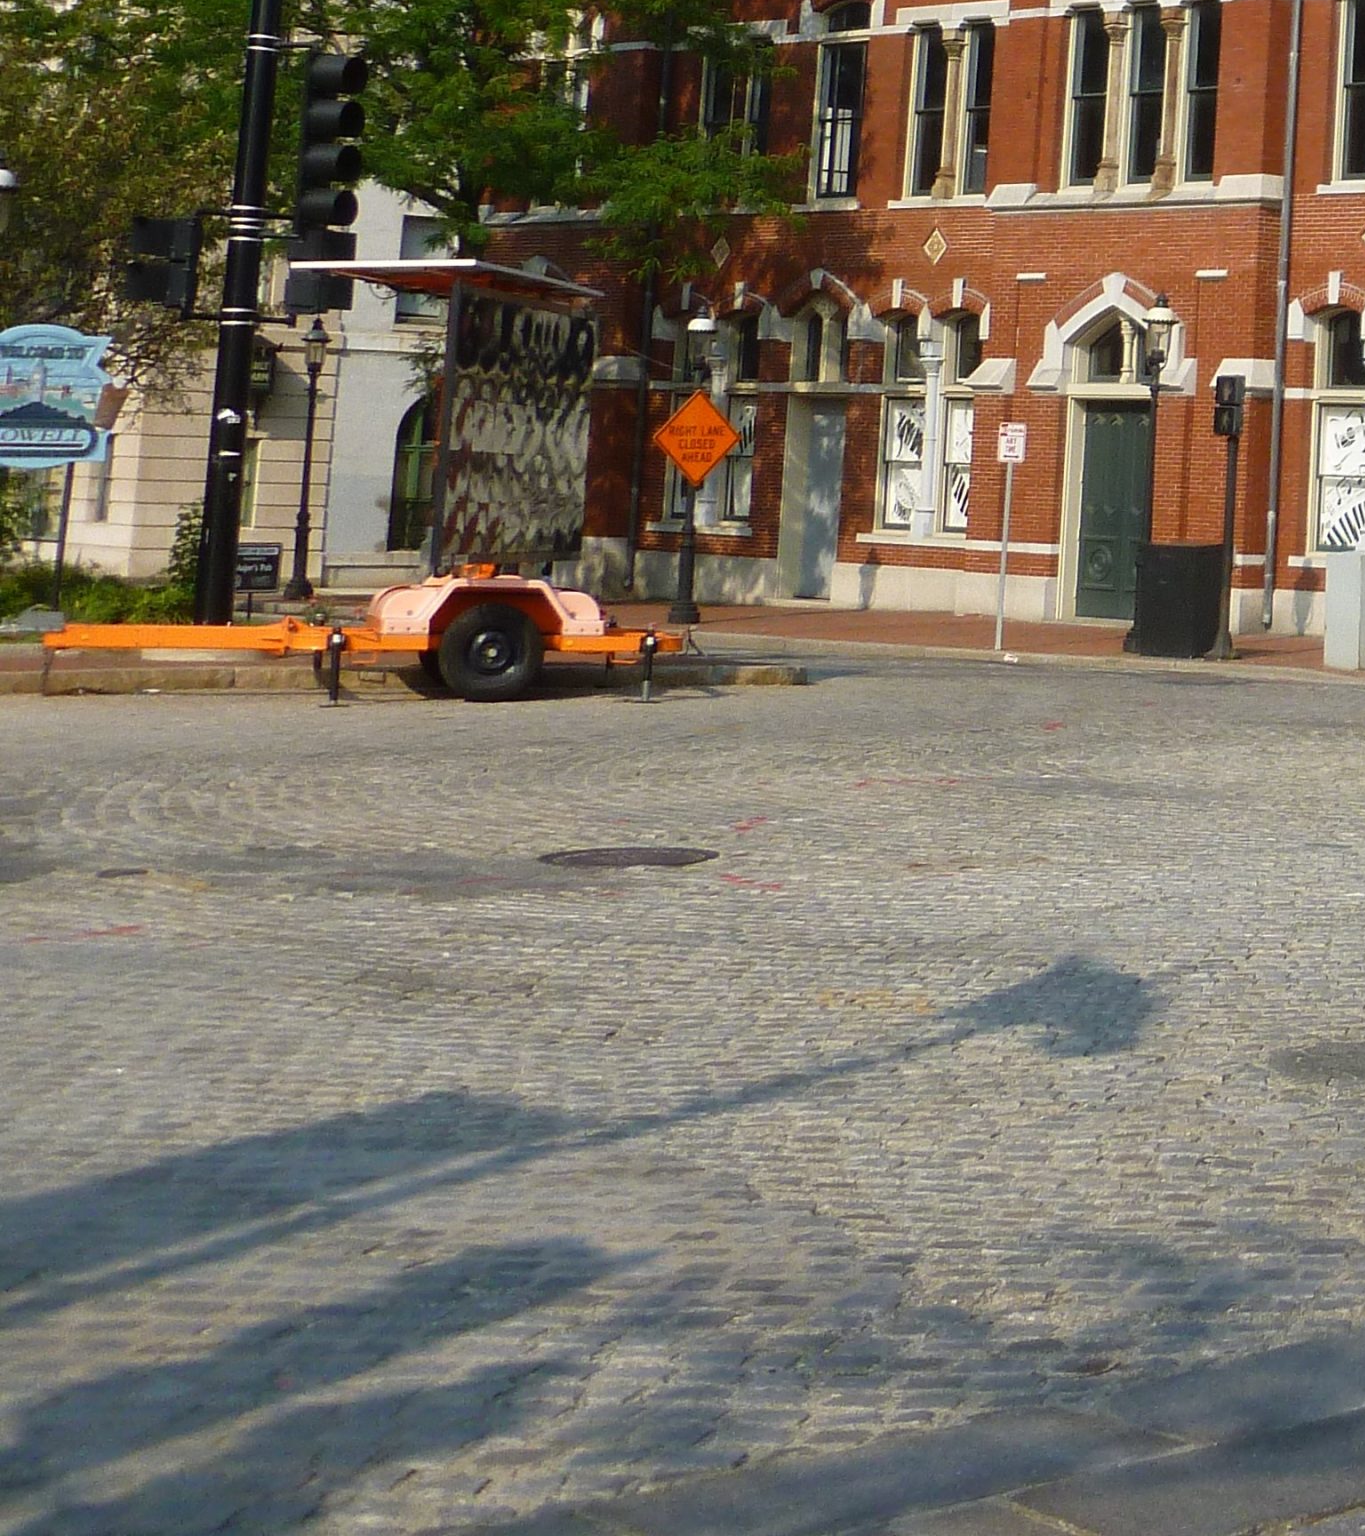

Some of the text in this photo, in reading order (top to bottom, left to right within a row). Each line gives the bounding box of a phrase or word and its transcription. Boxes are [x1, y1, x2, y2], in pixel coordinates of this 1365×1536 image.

[0, 428, 85, 442] OWELL
[669, 425, 727, 437] RIGHT LANE
[678, 438, 715, 450] CLOSED
[681, 451, 713, 463] AHEAD
